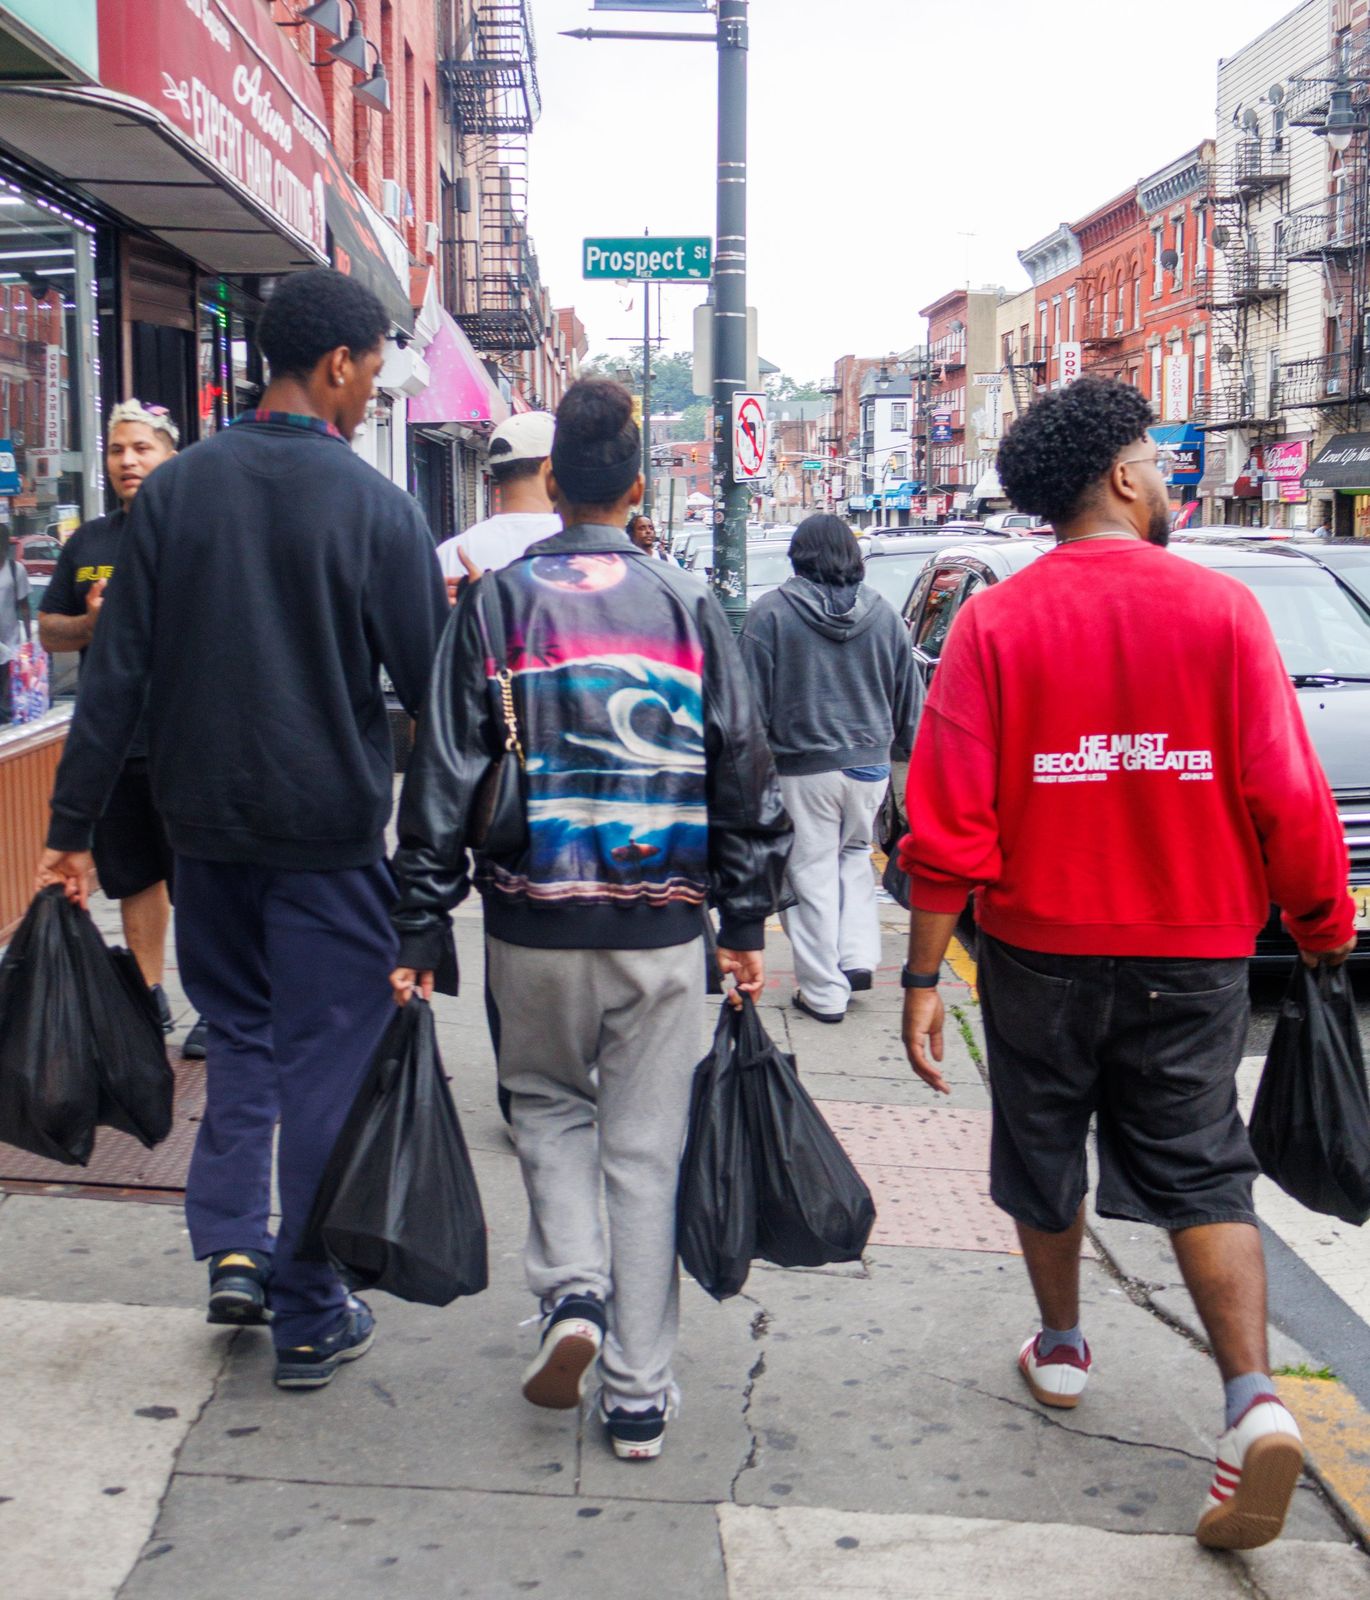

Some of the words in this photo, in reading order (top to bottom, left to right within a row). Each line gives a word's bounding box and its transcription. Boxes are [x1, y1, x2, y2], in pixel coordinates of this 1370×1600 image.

[191, 76, 244, 180] EXPERT
[245, 129, 273, 208] HAIR
[586, 246, 685, 277] Prospect
[693, 246, 707, 259] St
[1171, 356, 1182, 398] INCOME
[1172, 400, 1182, 420] TAX
[1318, 449, 1347, 463] Level
[1340, 448, 1358, 465] Up
[1080, 735, 1107, 753] HE
[1111, 734, 1168, 753] MUST
[1033, 751, 1120, 773] BECOME
[1123, 751, 1212, 771] GREATER
